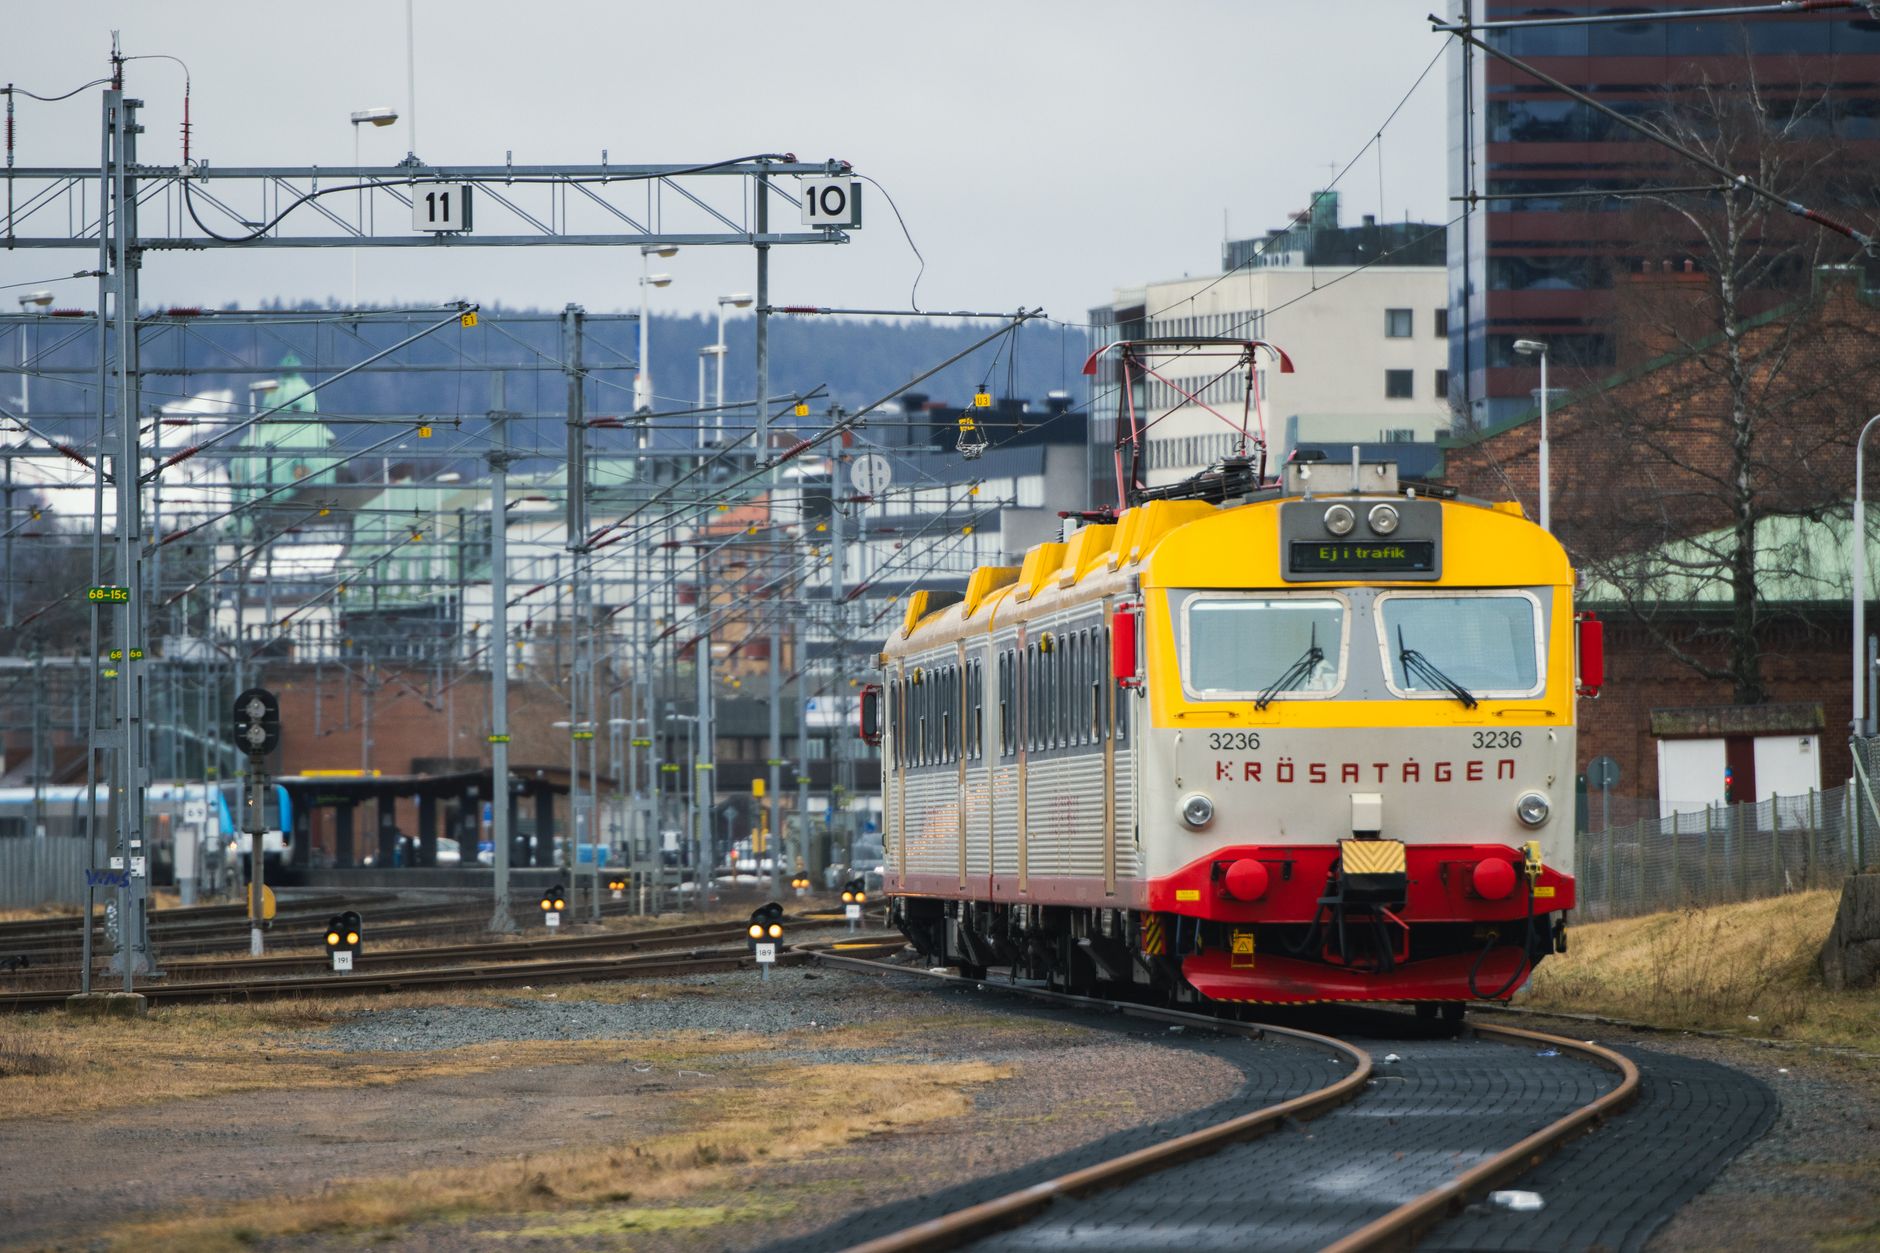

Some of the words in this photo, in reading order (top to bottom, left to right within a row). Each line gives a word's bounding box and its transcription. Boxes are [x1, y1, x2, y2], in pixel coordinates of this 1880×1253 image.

[425, 191, 449, 223] 11
[806, 185, 846, 216] 10
[463, 316, 474, 327] E1
[977, 396, 988, 406] U3
[1319, 547, 1338, 562] Ej
[1343, 547, 1349, 559] i
[1355, 547, 1406, 559] trafik
[88, 588, 128, 600] 68-15c
[1209, 732, 1261, 750] 3236
[1472, 730, 1523, 749] 3236
[1215, 756, 1516, 784] KRÖSATÅGEN
[337, 956, 350, 964] 191
[759, 949, 772, 957] 189
